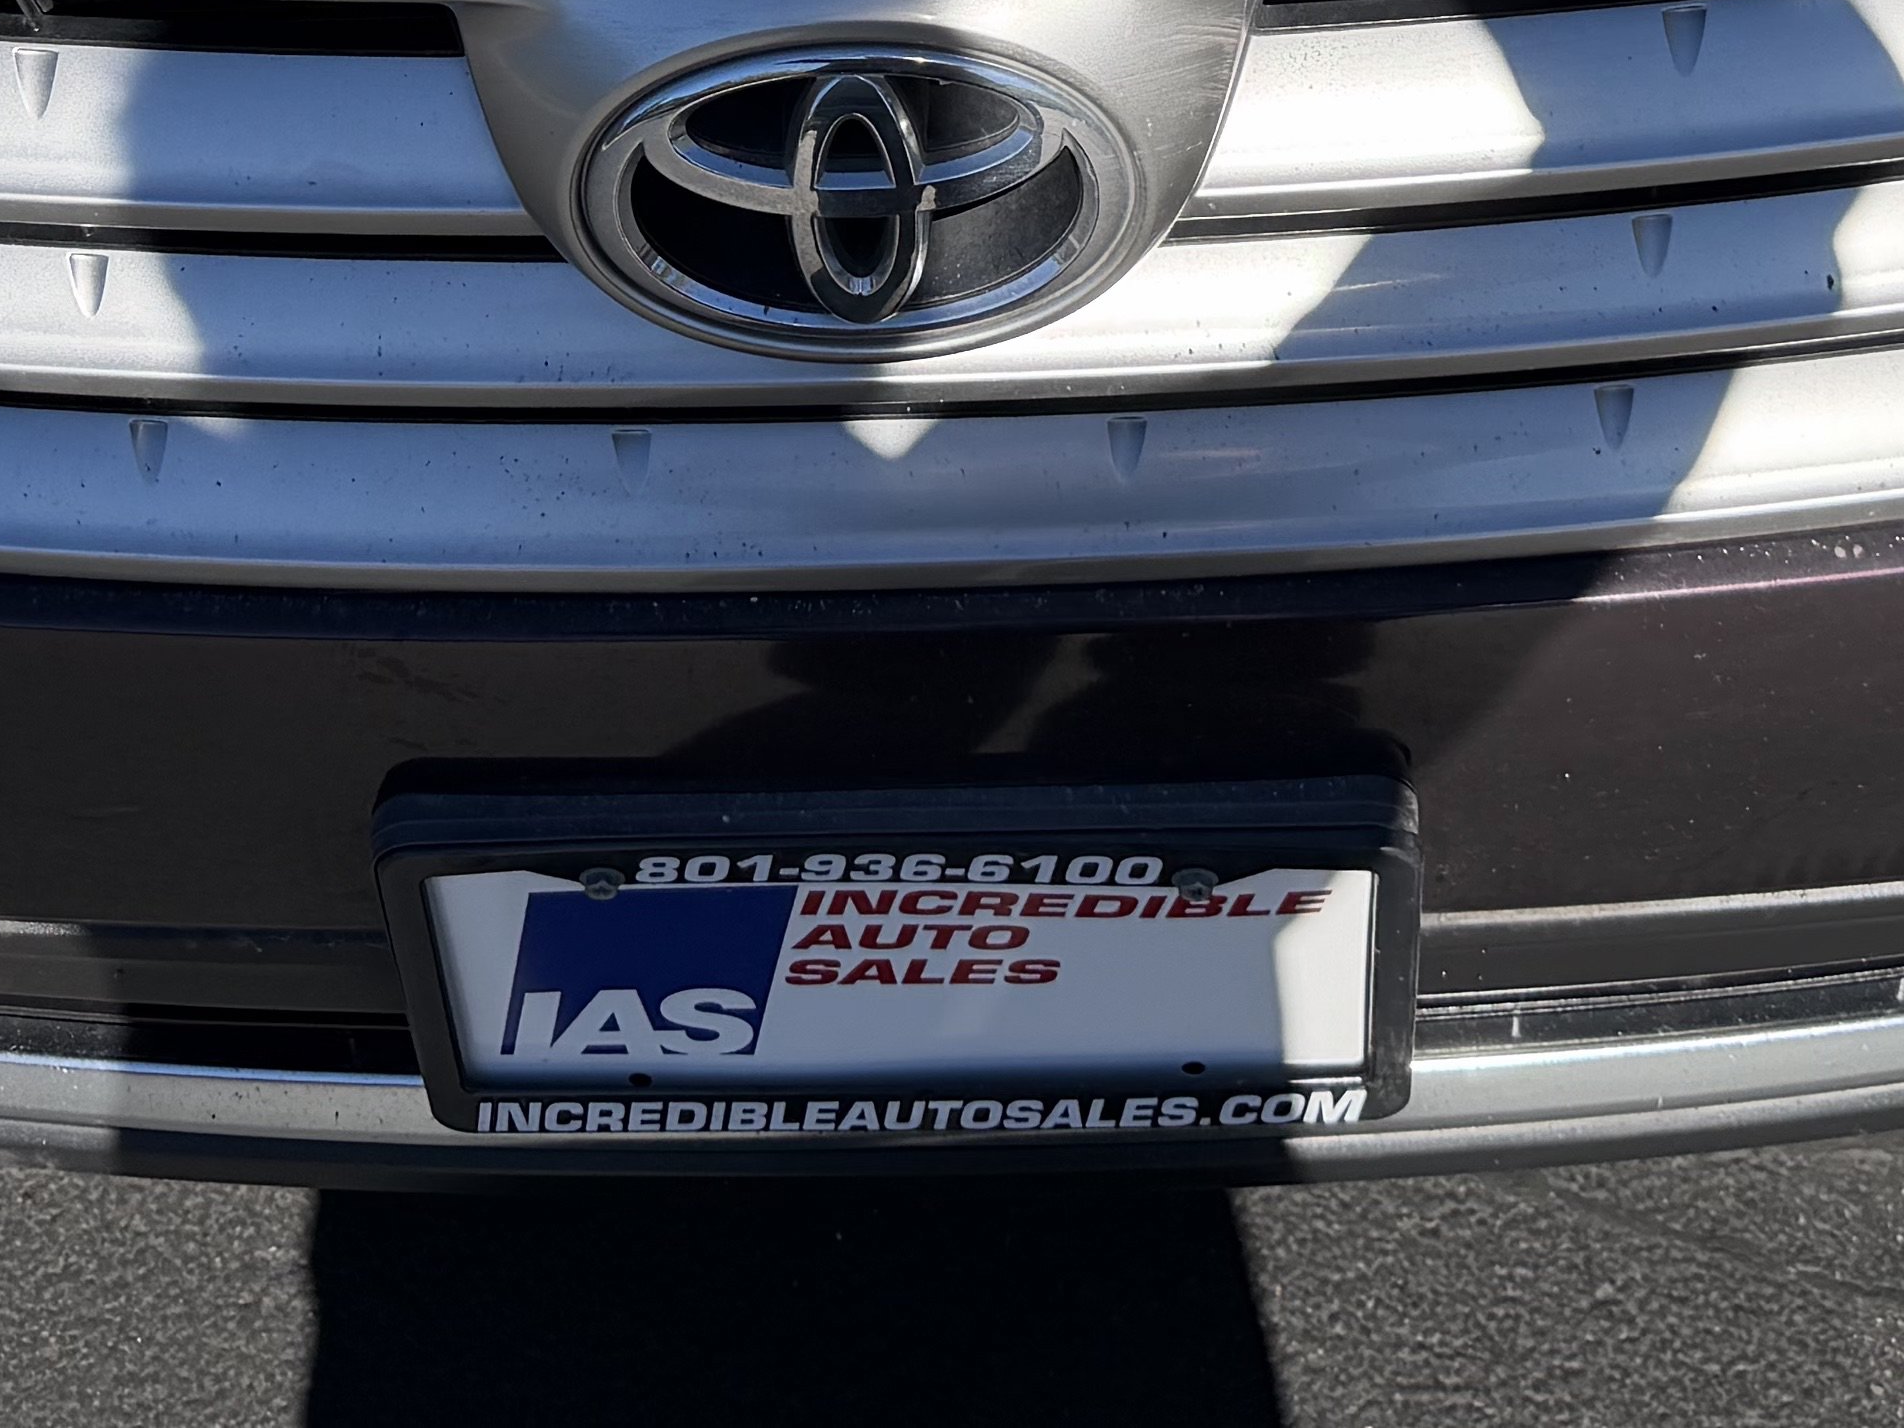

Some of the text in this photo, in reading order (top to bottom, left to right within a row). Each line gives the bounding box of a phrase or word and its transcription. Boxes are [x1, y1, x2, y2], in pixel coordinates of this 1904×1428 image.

[635, 853, 1163, 886] 801-936-6100
[799, 889, 1332, 920] INCREDIBLE
[791, 923, 1030, 950] AUTO
[784, 958, 1061, 985] SALES
[513, 988, 757, 1056] IAS
[477, 1089, 1368, 1133] INCREDIBLEAUTOSALES.COM
